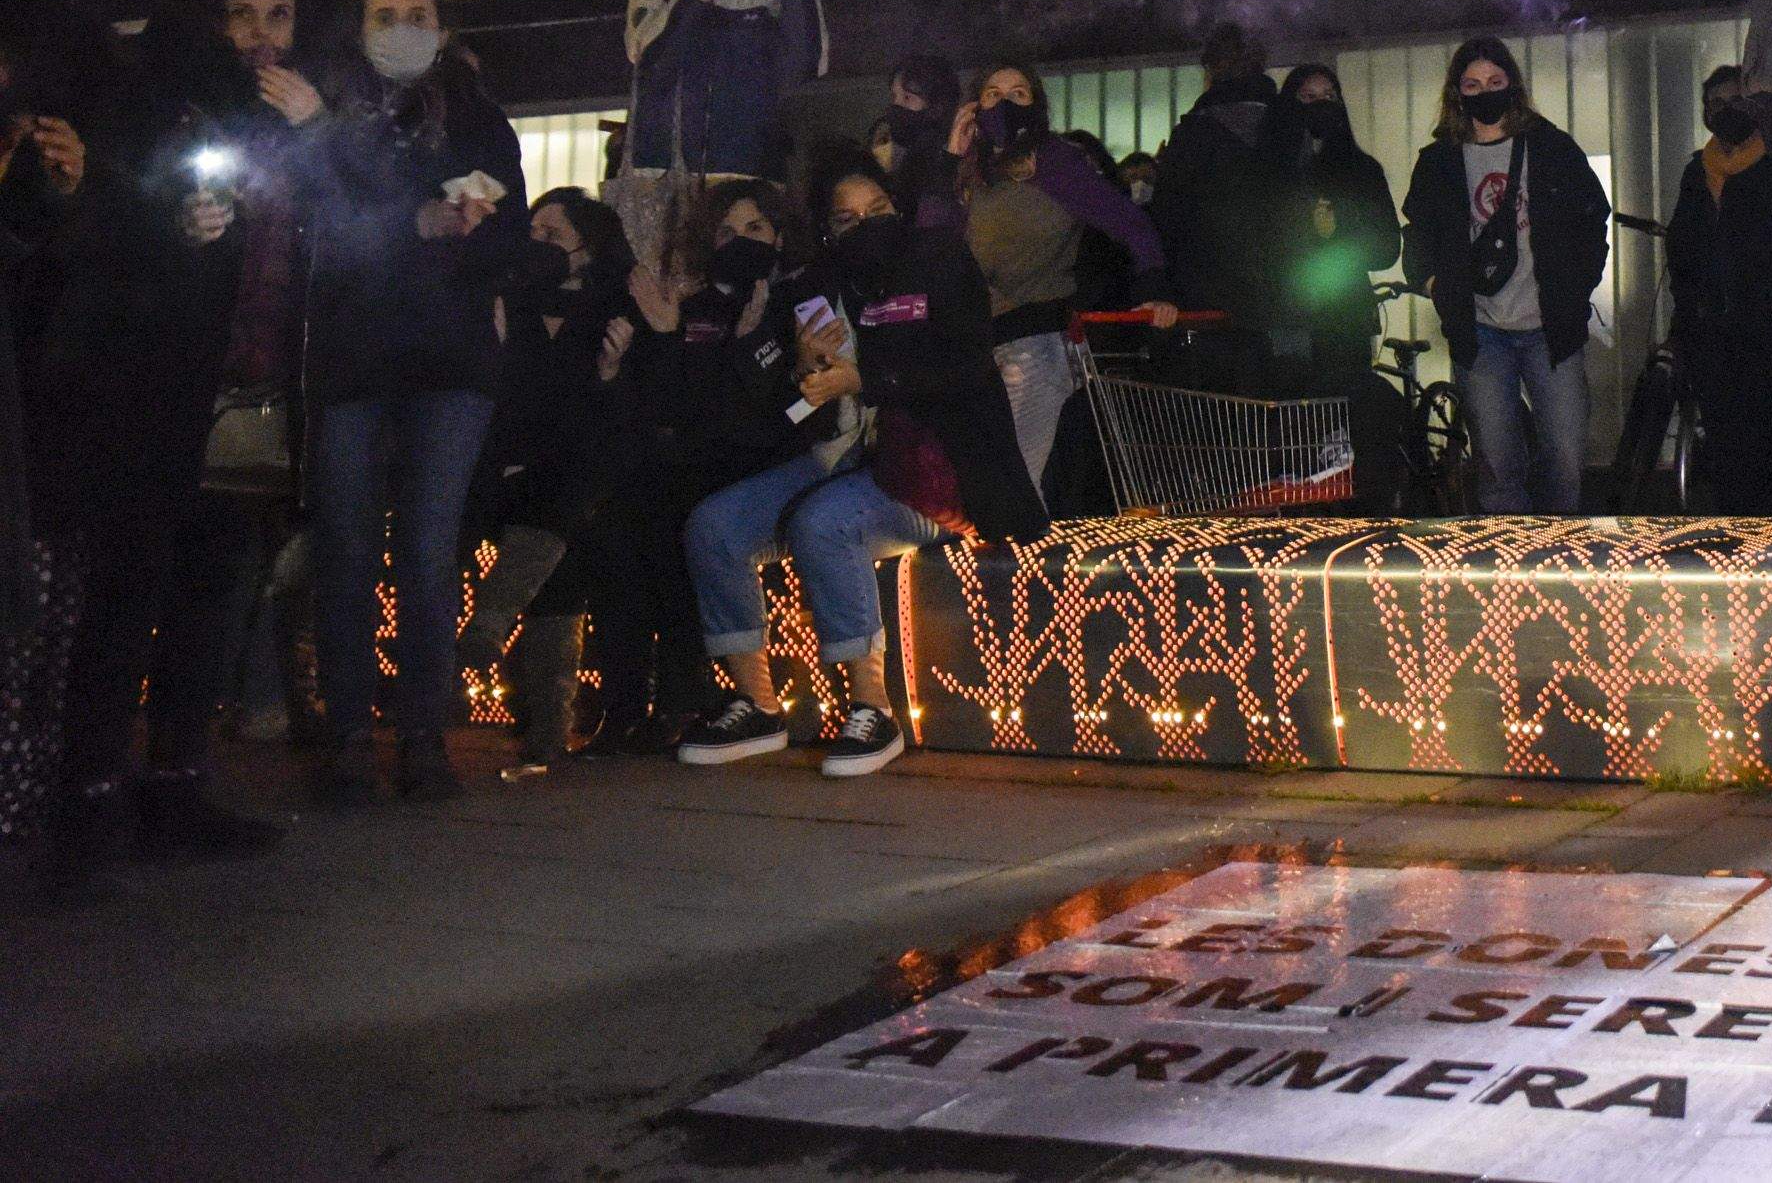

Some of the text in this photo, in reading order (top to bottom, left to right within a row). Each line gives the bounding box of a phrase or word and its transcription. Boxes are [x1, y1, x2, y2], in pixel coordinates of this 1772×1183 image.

[1101, 917, 1344, 953] LES
[984, 970, 1325, 1012] SOM
[843, 1029, 969, 1068] A
[983, 1035, 1688, 1119] PRIMERA
